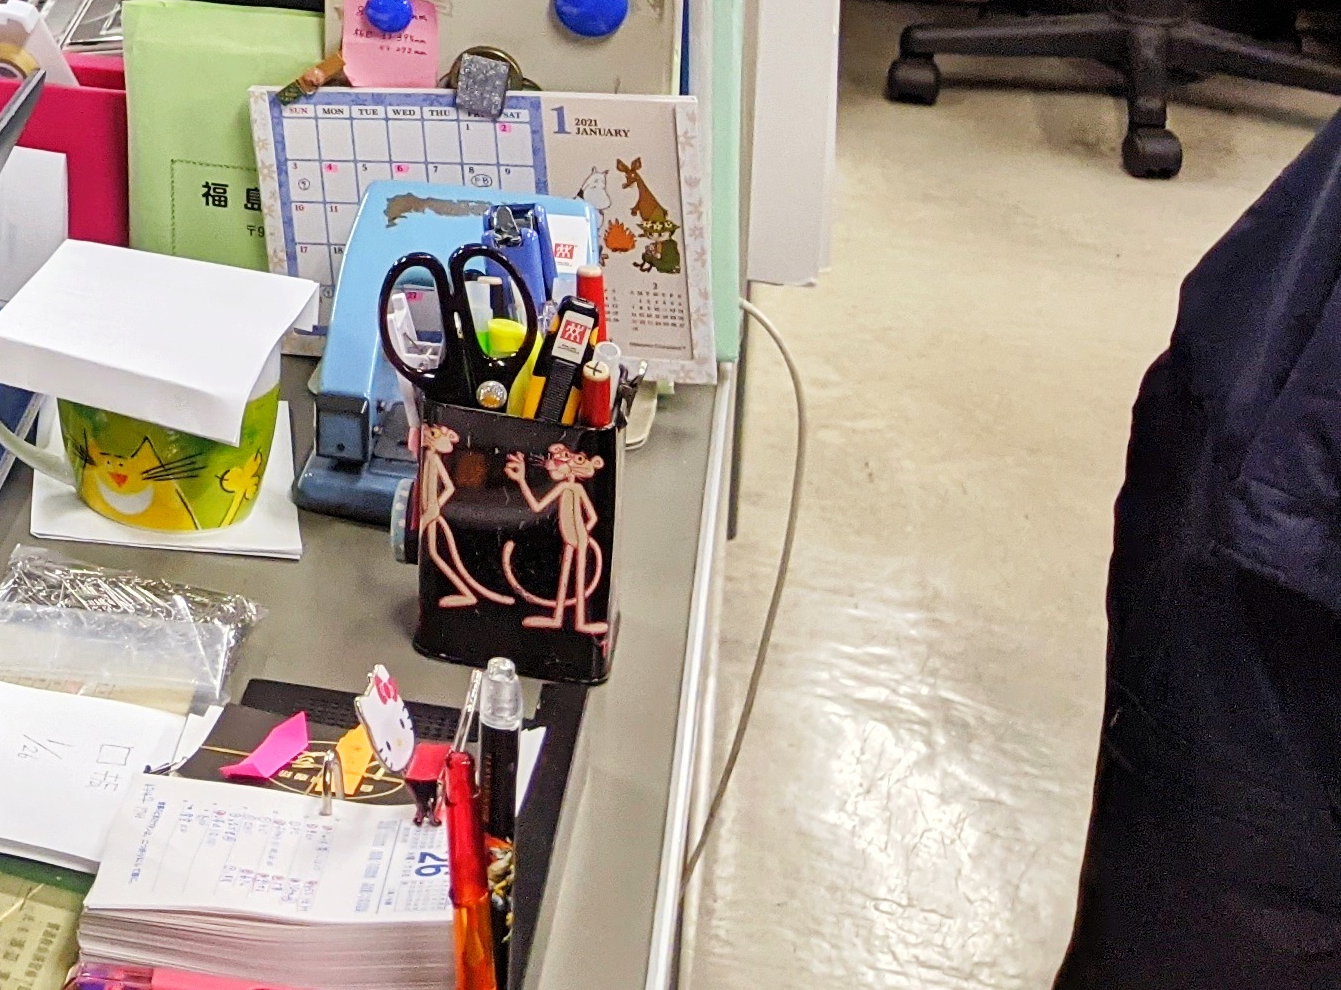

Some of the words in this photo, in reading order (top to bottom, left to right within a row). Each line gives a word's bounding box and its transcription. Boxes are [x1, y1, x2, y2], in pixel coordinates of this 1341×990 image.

[322, 107, 344, 115] MON
[358, 108, 378, 116] TUE
[429, 109, 450, 117] THU
[550, 105, 572, 135] 1
[574, 117, 598, 127] 2021
[501, 124, 507, 132] 2
[575, 127, 630, 139] JANUARY
[292, 162, 298, 170] 3
[326, 163, 332, 171] 4
[362, 163, 368, 171] 5
[397, 164, 403, 172] 6
[433, 165, 439, 173] 7
[468, 166, 475, 174] 8
[295, 204, 305, 212] 10
[330, 205, 338, 213] 11
[300, 246, 308, 254] 17
[333, 246, 343, 254] 18
[415, 851, 448, 877] 26
